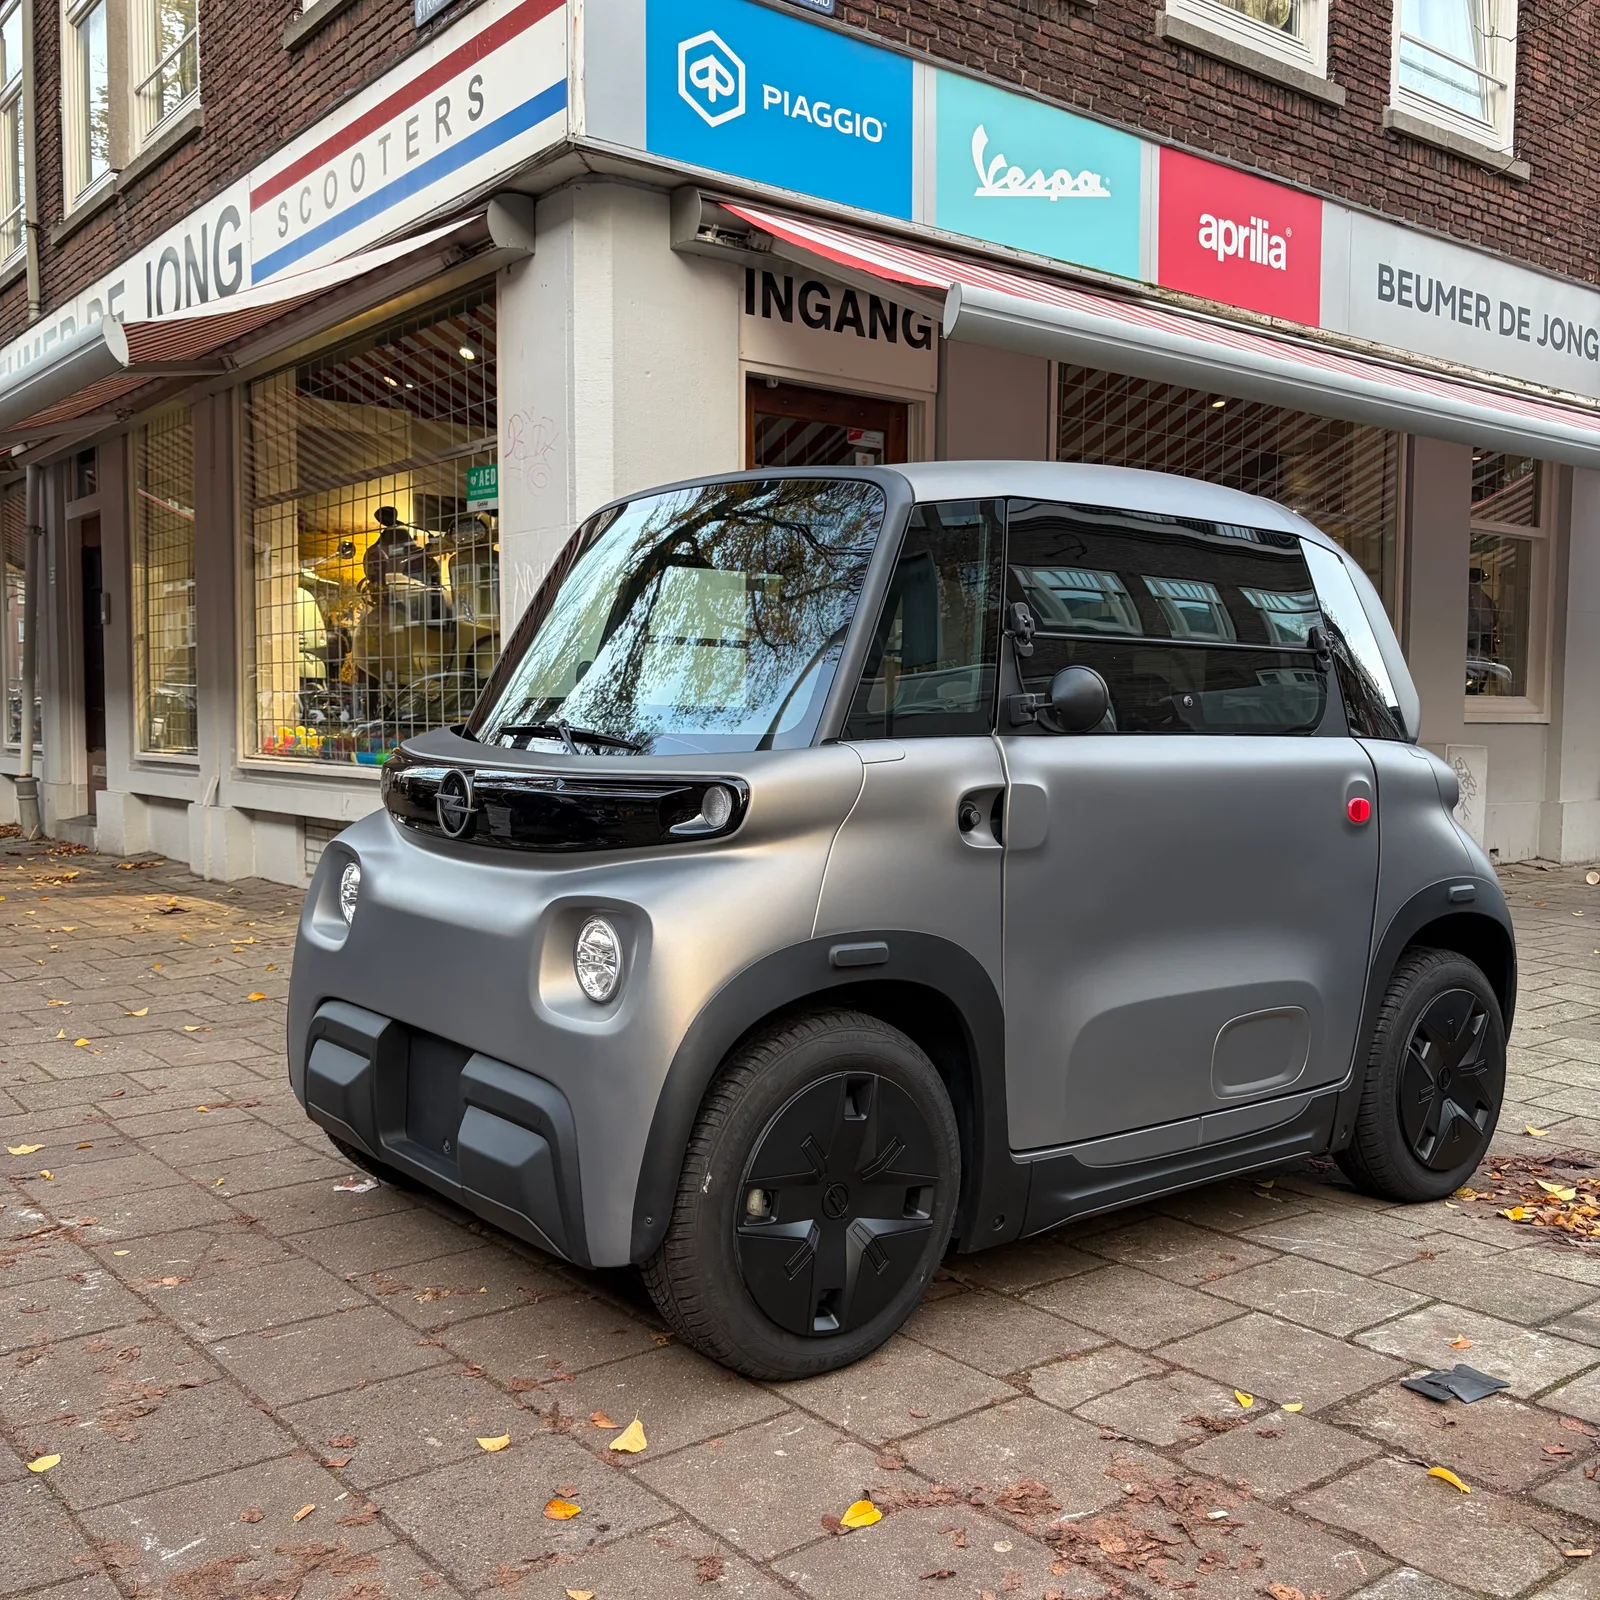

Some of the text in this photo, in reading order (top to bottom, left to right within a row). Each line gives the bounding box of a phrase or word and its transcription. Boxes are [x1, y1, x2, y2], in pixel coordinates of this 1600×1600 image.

[762, 84, 883, 142] PIAGGIO
[278, 74, 484, 237] SCOOTERS
[972, 124, 1111, 201] Vespa
[1198, 213, 1287, 271] aprilia
[745, 268, 931, 350] INGANG
[1378, 263, 1599, 362] BEUMER DE JONG
[479, 468, 496, 487] AED
